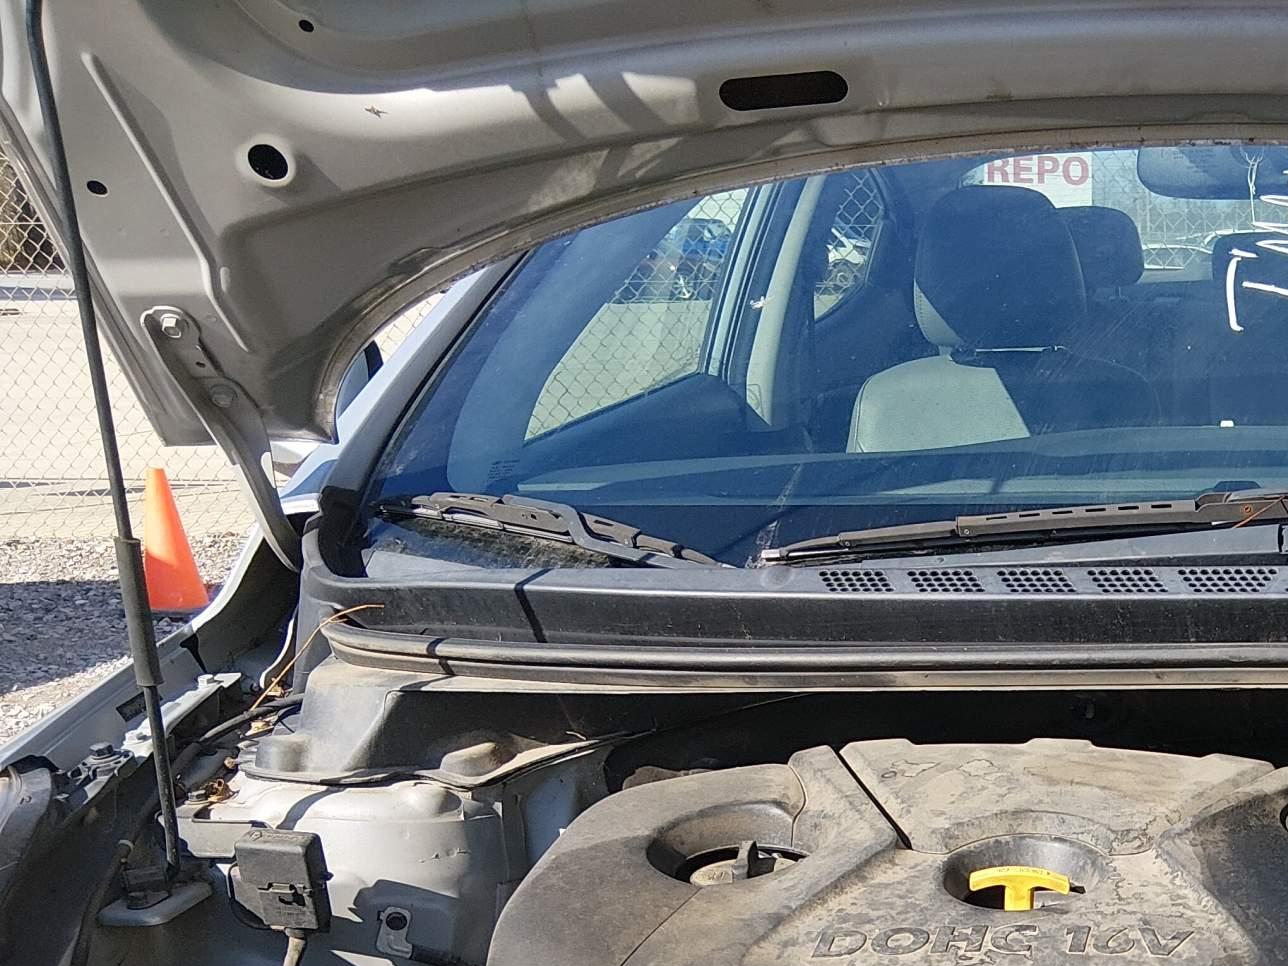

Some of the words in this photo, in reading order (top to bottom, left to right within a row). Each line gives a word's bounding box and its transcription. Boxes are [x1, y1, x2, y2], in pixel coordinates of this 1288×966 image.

[986, 155, 1090, 186] REPO
[811, 924, 1038, 960] DOHC
[1065, 925, 1194, 957] 16V
